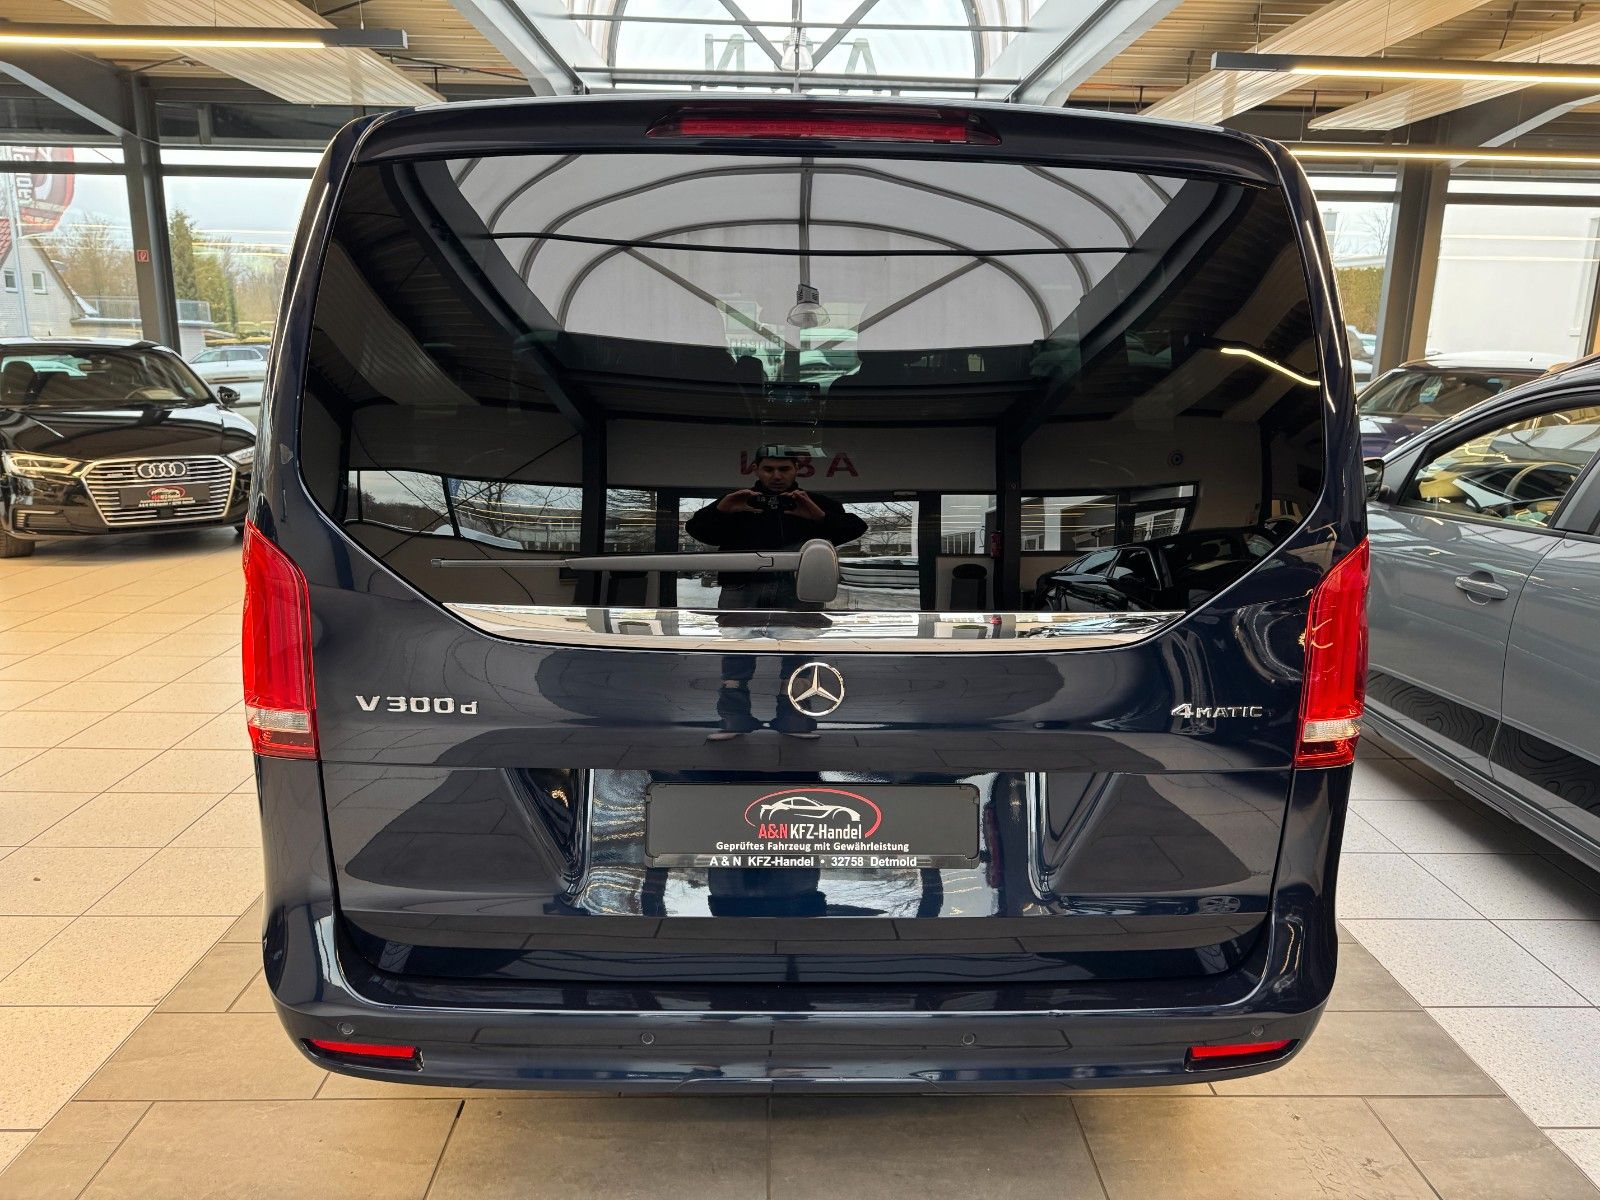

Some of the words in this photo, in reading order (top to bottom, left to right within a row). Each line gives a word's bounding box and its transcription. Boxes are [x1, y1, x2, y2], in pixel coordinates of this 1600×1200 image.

[1171, 703, 1263, 719] 4MATIC
[758, 823, 788, 839] A&N
[790, 823, 862, 839] KFZ-Handel
[716, 841, 765, 852] Geprüftes
[767, 841, 811, 852] Fahrzeug
[814, 842, 831, 851] mit
[833, 841, 910, 853] Gewährleistung
[748, 856, 815, 867] KFZ-Handel
[831, 856, 864, 867] 32758
[870, 856, 918, 867] Detmold
